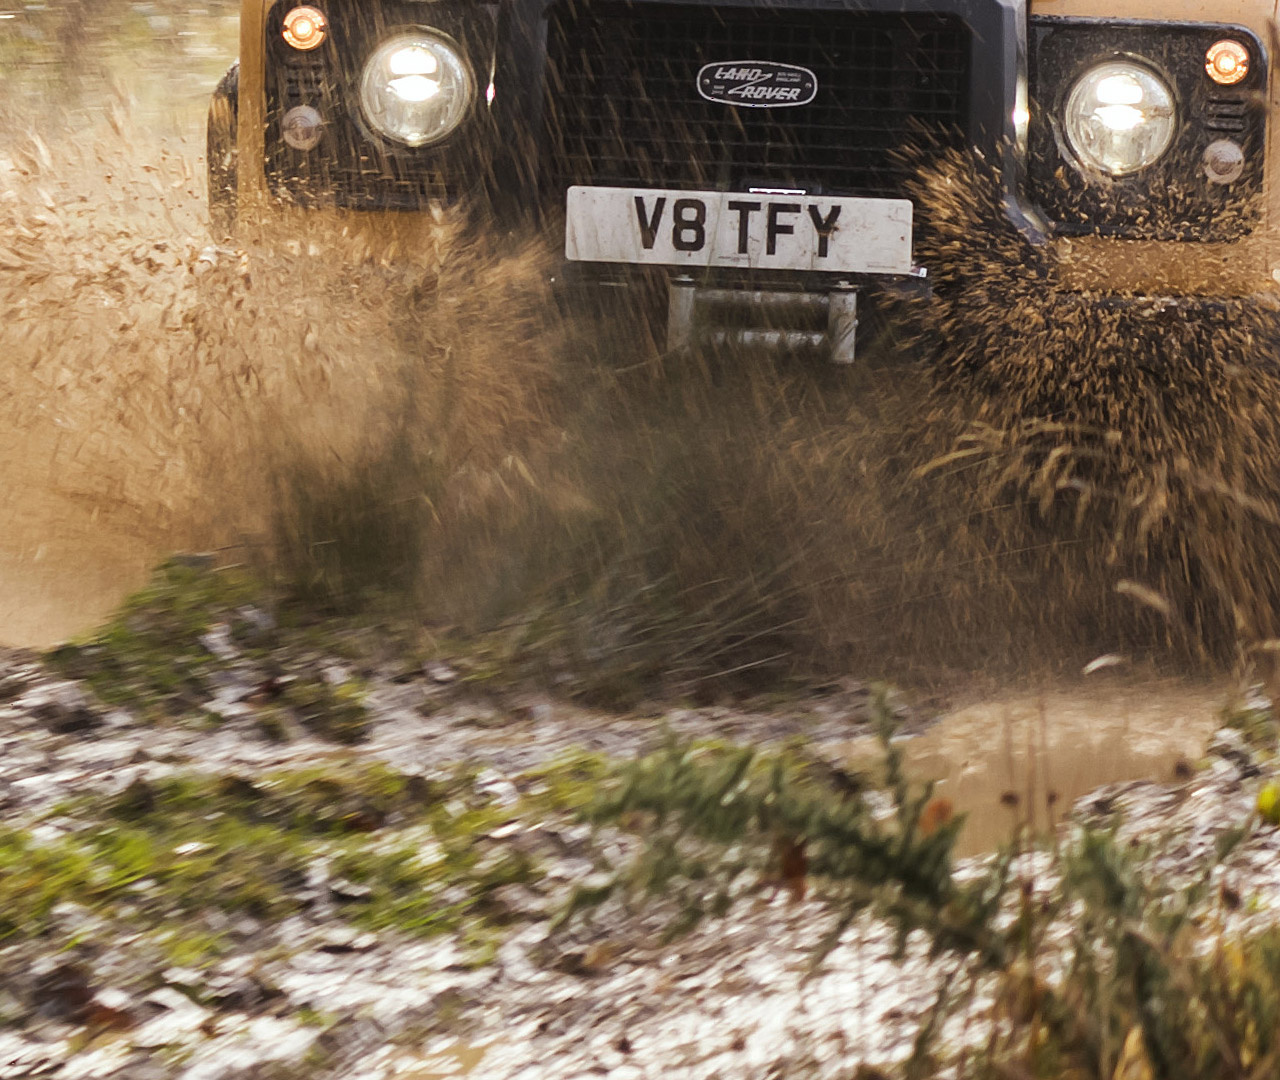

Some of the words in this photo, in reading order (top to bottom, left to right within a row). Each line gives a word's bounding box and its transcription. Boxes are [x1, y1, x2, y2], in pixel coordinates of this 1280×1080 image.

[714, 67, 763, 81] LAND
[741, 86, 802, 100] ROVER
[634, 196, 707, 252] V8
[728, 201, 842, 258] TFY
